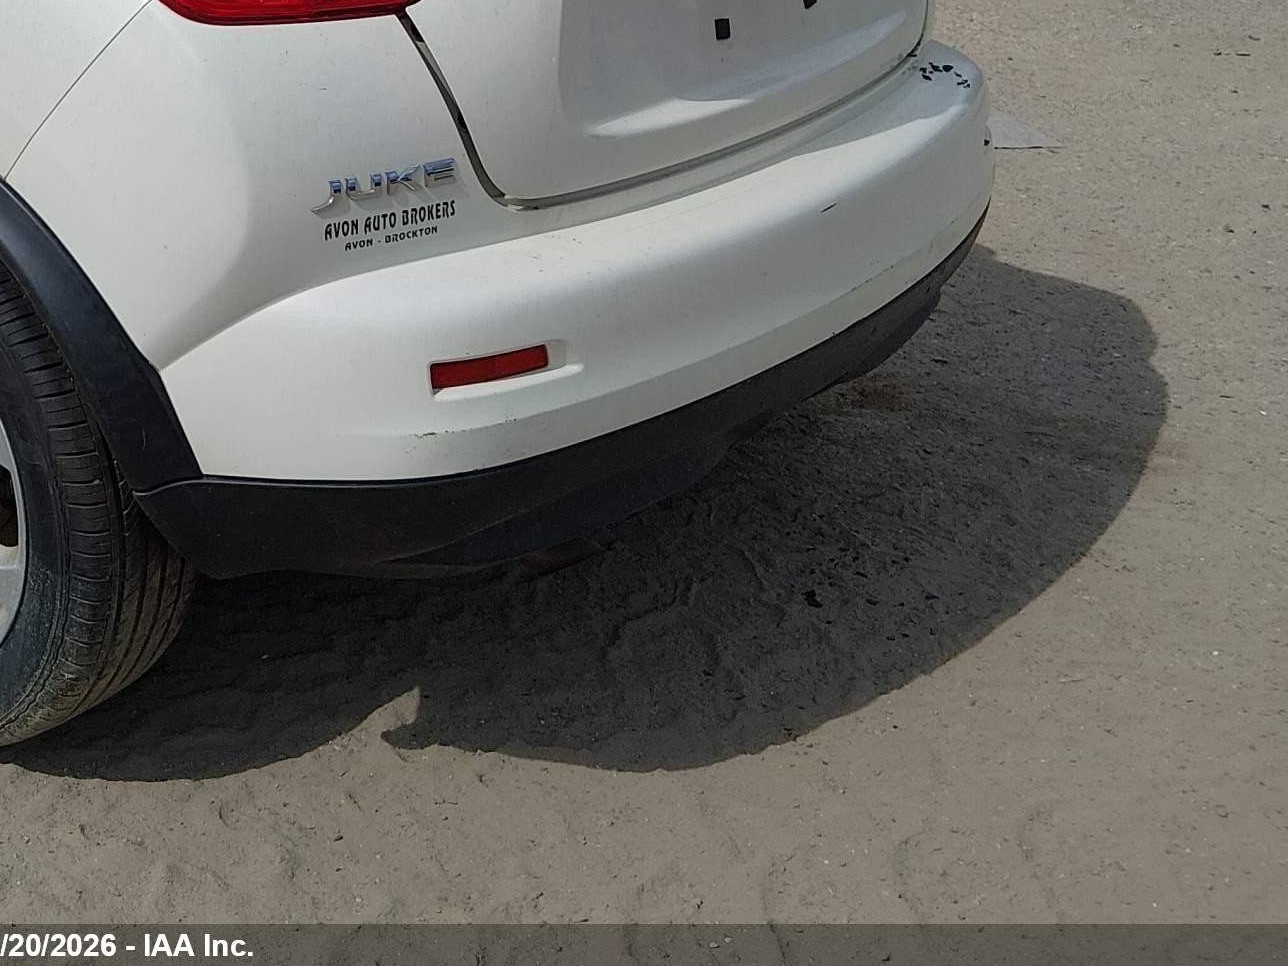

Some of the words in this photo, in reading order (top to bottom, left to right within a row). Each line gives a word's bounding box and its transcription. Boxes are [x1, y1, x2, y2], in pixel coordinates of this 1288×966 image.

[311, 157, 456, 213] JUKE
[324, 218, 359, 241] AVON
[364, 212, 397, 235] AUTO
[402, 200, 456, 226] BROKERS
[345, 238, 373, 251] AVON
[385, 226, 438, 244] BROCKTON
